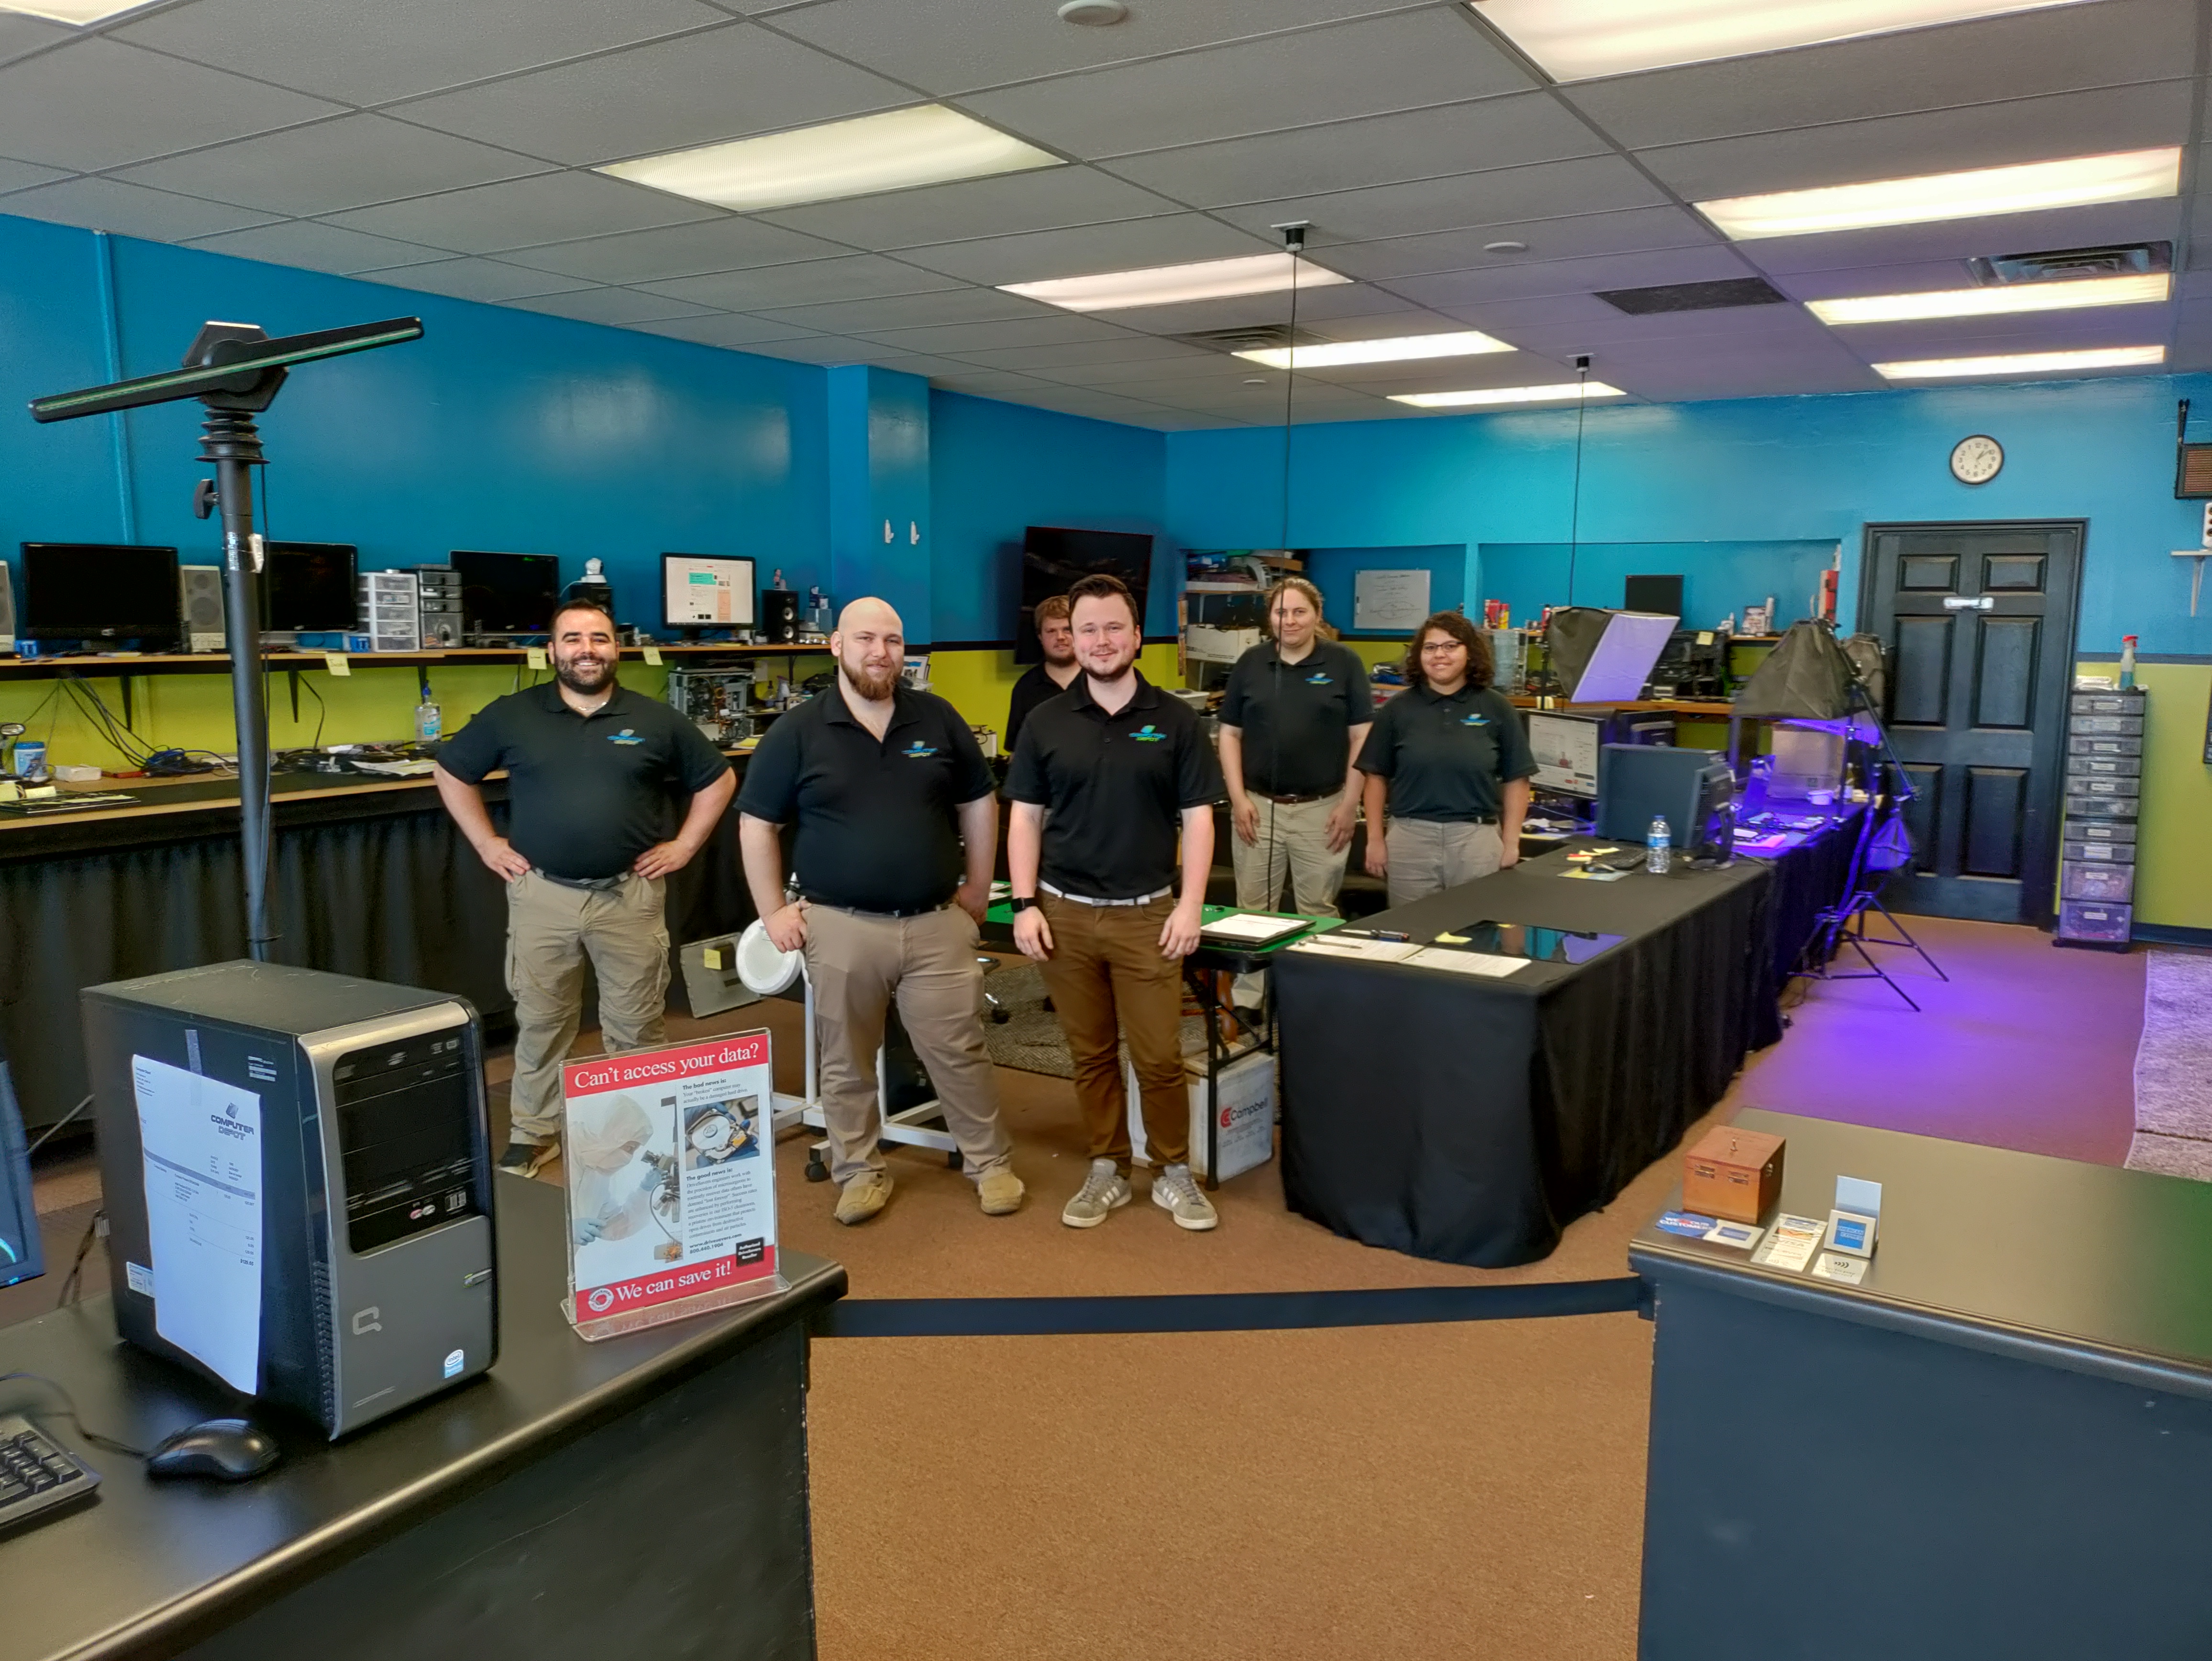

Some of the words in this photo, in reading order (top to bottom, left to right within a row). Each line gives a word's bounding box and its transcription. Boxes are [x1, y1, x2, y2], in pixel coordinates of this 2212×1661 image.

[575, 1067, 620, 1088] Can't
[623, 1061, 676, 1081] access
[679, 1054, 715, 1075] your
[719, 1042, 759, 1064] data?
[211, 1115, 254, 1135] COMPUTER
[218, 1126, 245, 1141] DEPOT
[697, 1172, 711, 1180] good
[689, 1233, 742, 1249] www.drivesavers.com
[616, 1284, 642, 1301] We
[646, 1278, 674, 1295] can
[678, 1269, 711, 1287] save
[715, 1261, 730, 1278] it!
